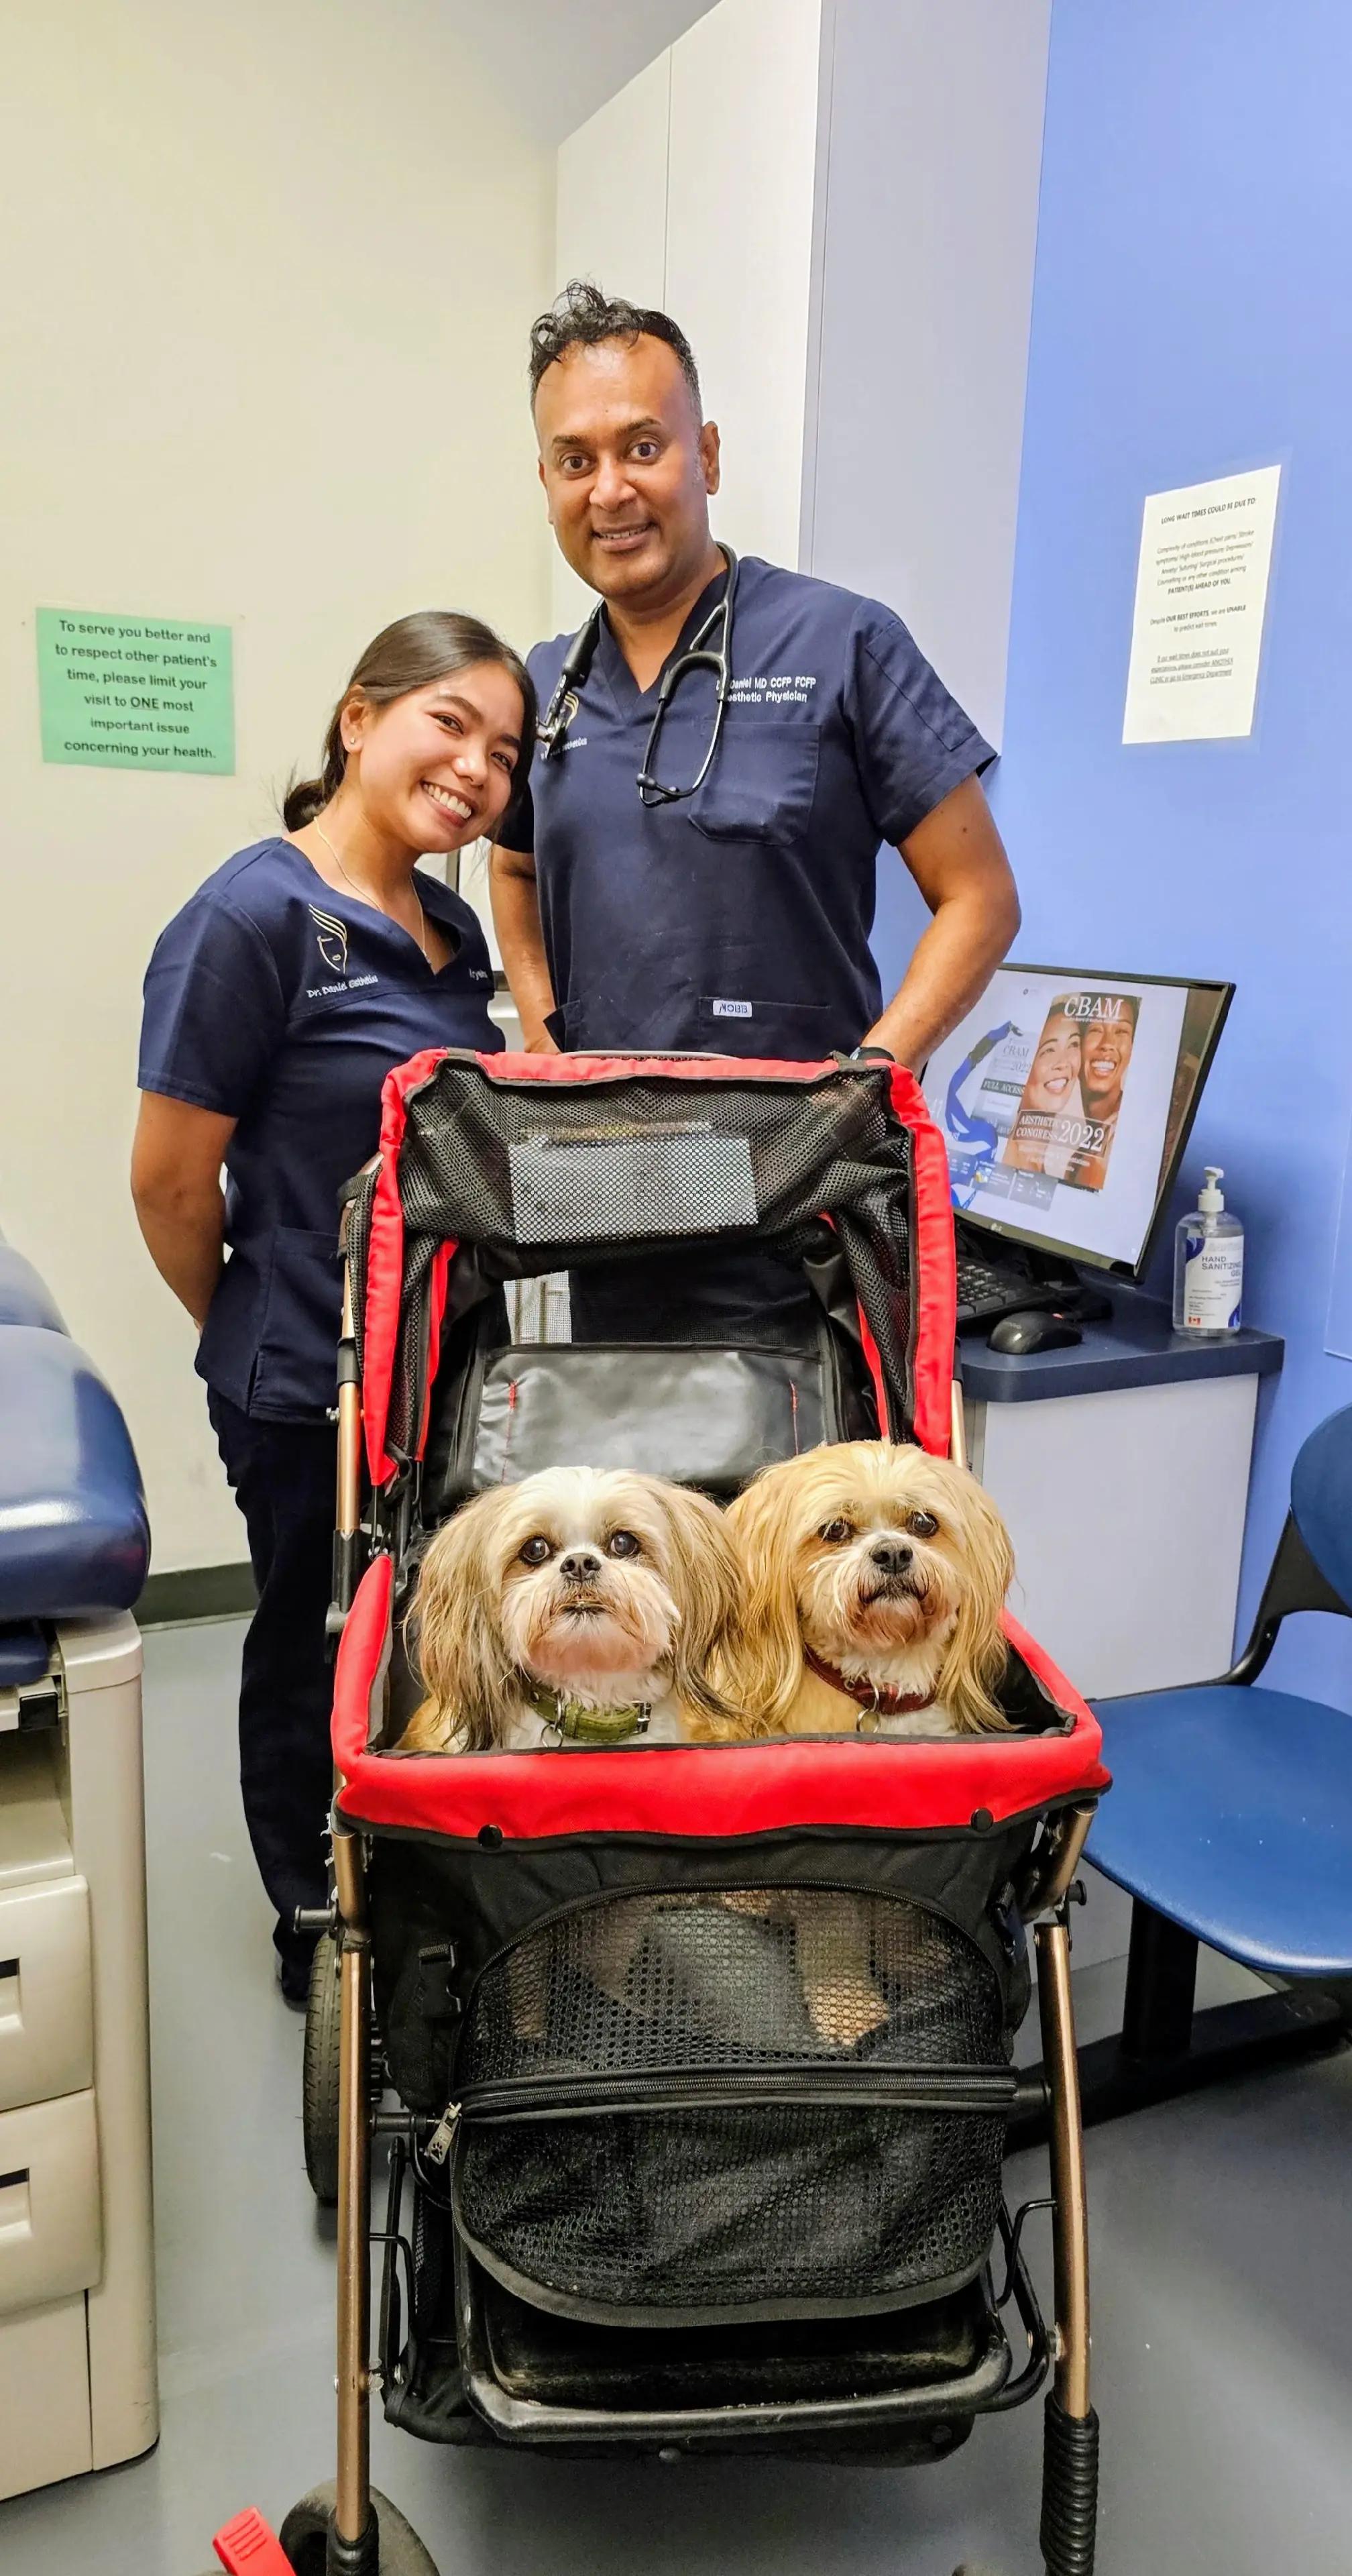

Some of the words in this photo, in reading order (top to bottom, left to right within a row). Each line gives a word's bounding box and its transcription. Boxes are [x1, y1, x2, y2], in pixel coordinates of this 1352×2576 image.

[1161, 515, 1175, 524] LONG
[1176, 512, 1190, 521] WAIT
[1192, 508, 1207, 518] TIMES
[1207, 504, 1226, 515] COULD
[1234, 499, 1246, 508] DUE
[1195, 581, 1211, 590] AHEAD
[1166, 614, 1176, 623] OUR
[1177, 612, 1188, 621] BEST
[59, 620, 75, 632] To
[78, 623, 115, 635] serve
[118, 627, 142, 638] you
[145, 627, 184, 641] better
[186, 633, 211, 643] and
[55, 643, 68, 655] to
[71, 645, 122, 660] respect
[125, 650, 160, 663] other
[163, 653, 217, 667] patient's
[67, 668, 100, 683] time,
[103, 670, 146, 687] please
[149, 675, 178, 688] limit
[179, 679, 208, 691] your
[730, 678, 752, 689] Daniel
[755, 677, 767, 689] MD
[771, 676, 792, 688] CCFP
[795, 676, 817, 689] FCFP
[84, 694, 111, 706] visit
[114, 696, 127, 707] to
[130, 697, 160, 710] ONE
[163, 700, 194, 712] most
[728, 692, 762, 703] esthetic
[765, 690, 807, 704] Physician
[90, 717, 154, 732] important
[156, 722, 190, 734] issue
[64, 741, 139, 756] concerning
[142, 746, 171, 757] your
[173, 746, 217, 759] health.
[306, 989, 322, 998] Dr.
[322, 981, 348, 995] Daniel
[1064, 996, 1123, 1018] CBAM
[982, 1079, 999, 1091] FULL
[1015, 1126, 1058, 1140] CONGRESS
[1019, 1114, 1060, 1128] AESTHETIC
[1059, 1119, 1105, 1152] 2022
